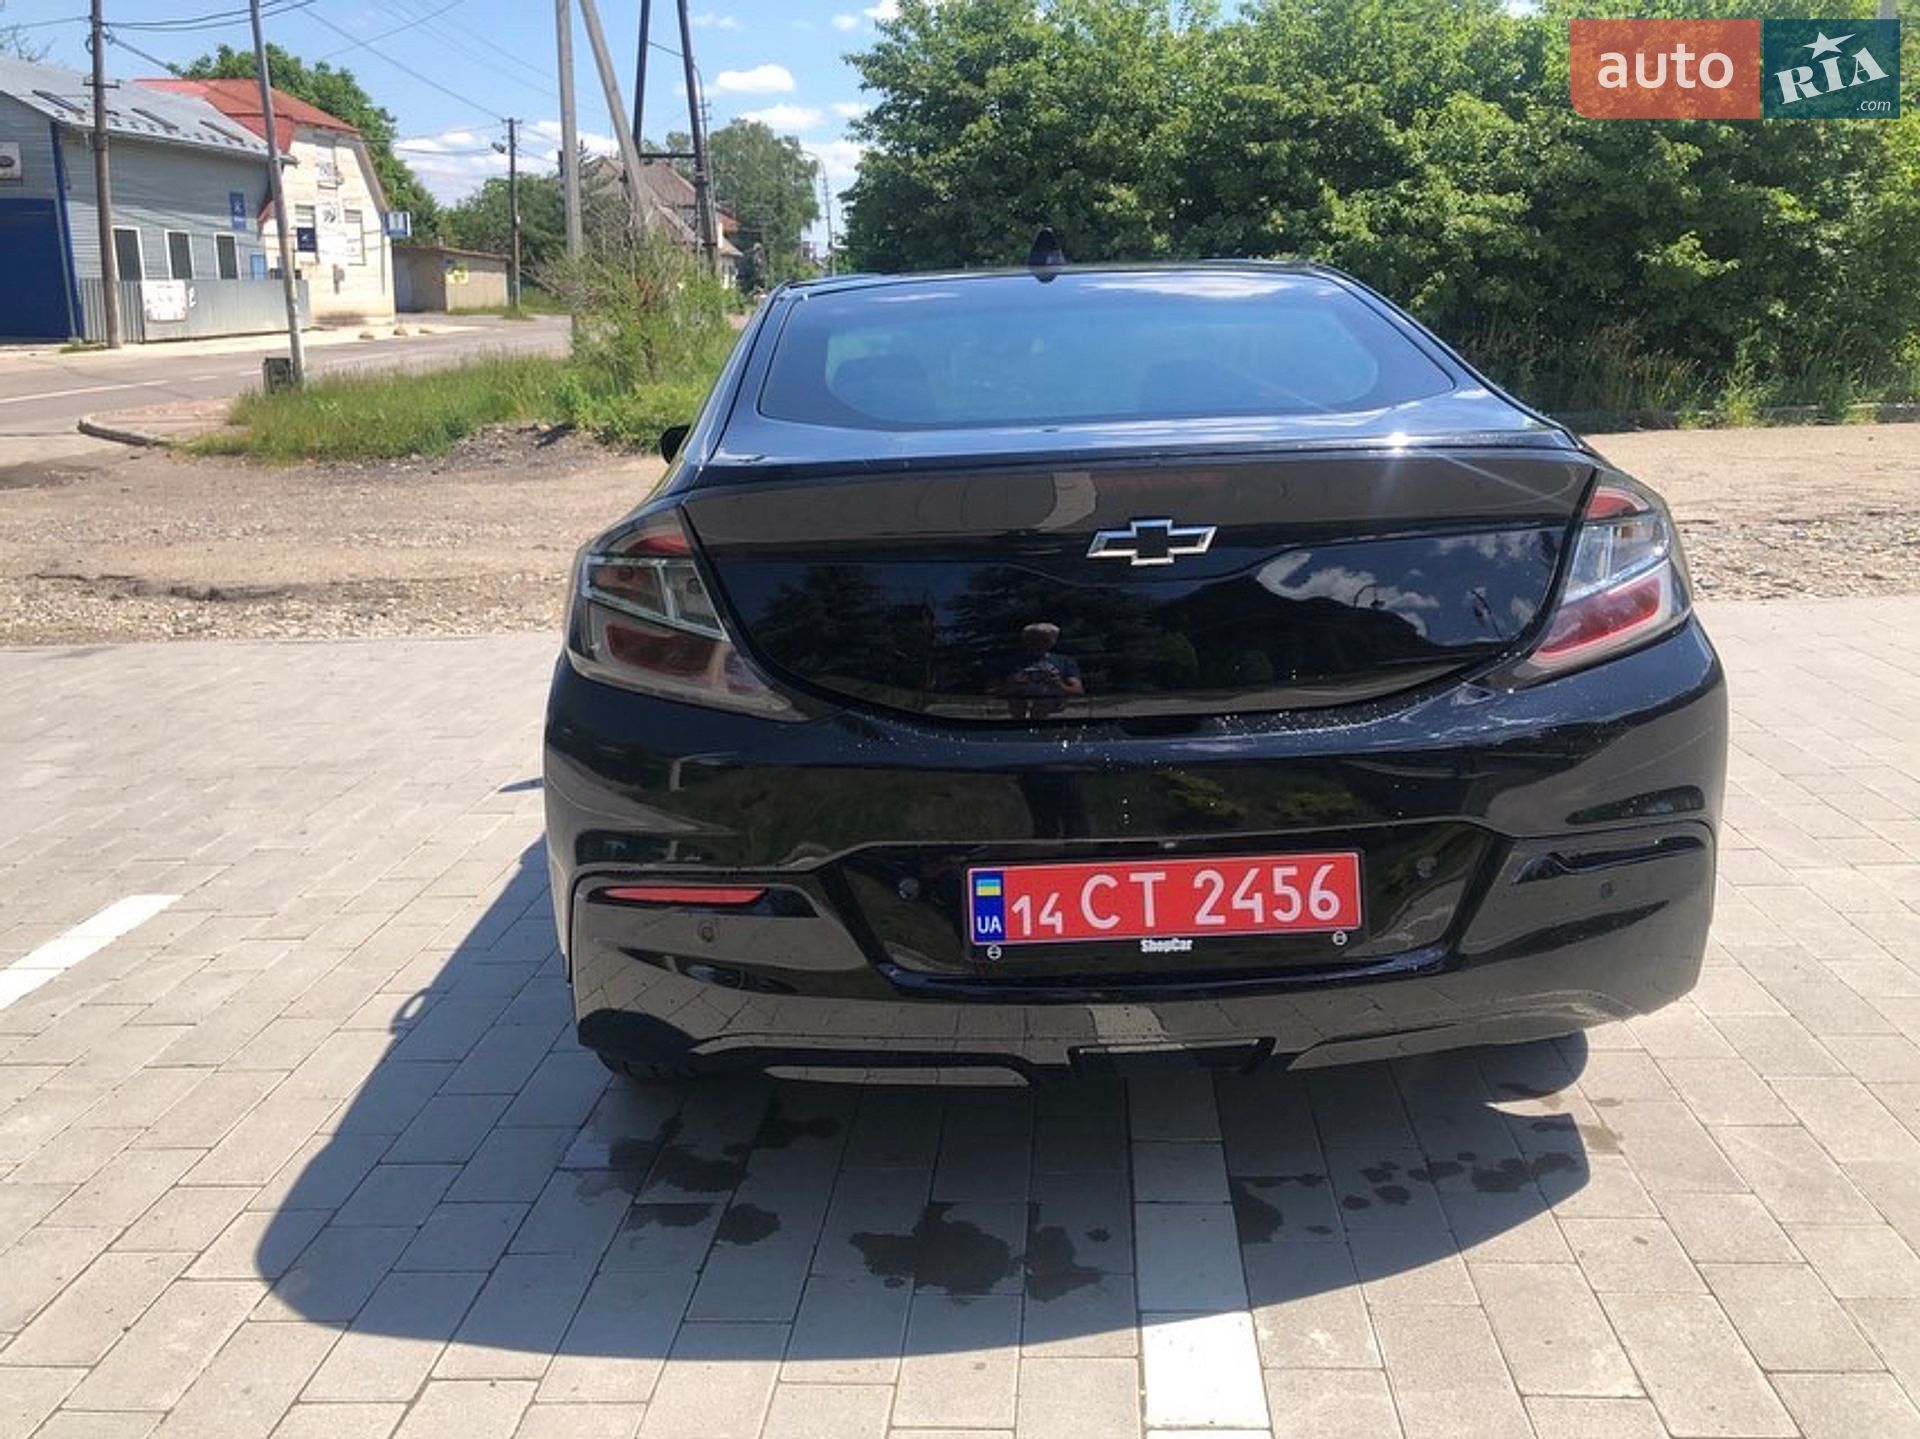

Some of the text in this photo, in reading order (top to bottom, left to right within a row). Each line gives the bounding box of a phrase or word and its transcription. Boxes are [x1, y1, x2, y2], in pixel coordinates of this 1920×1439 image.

[1011, 864, 1341, 936] 14 CT 2456
[977, 916, 1002, 934] UA
